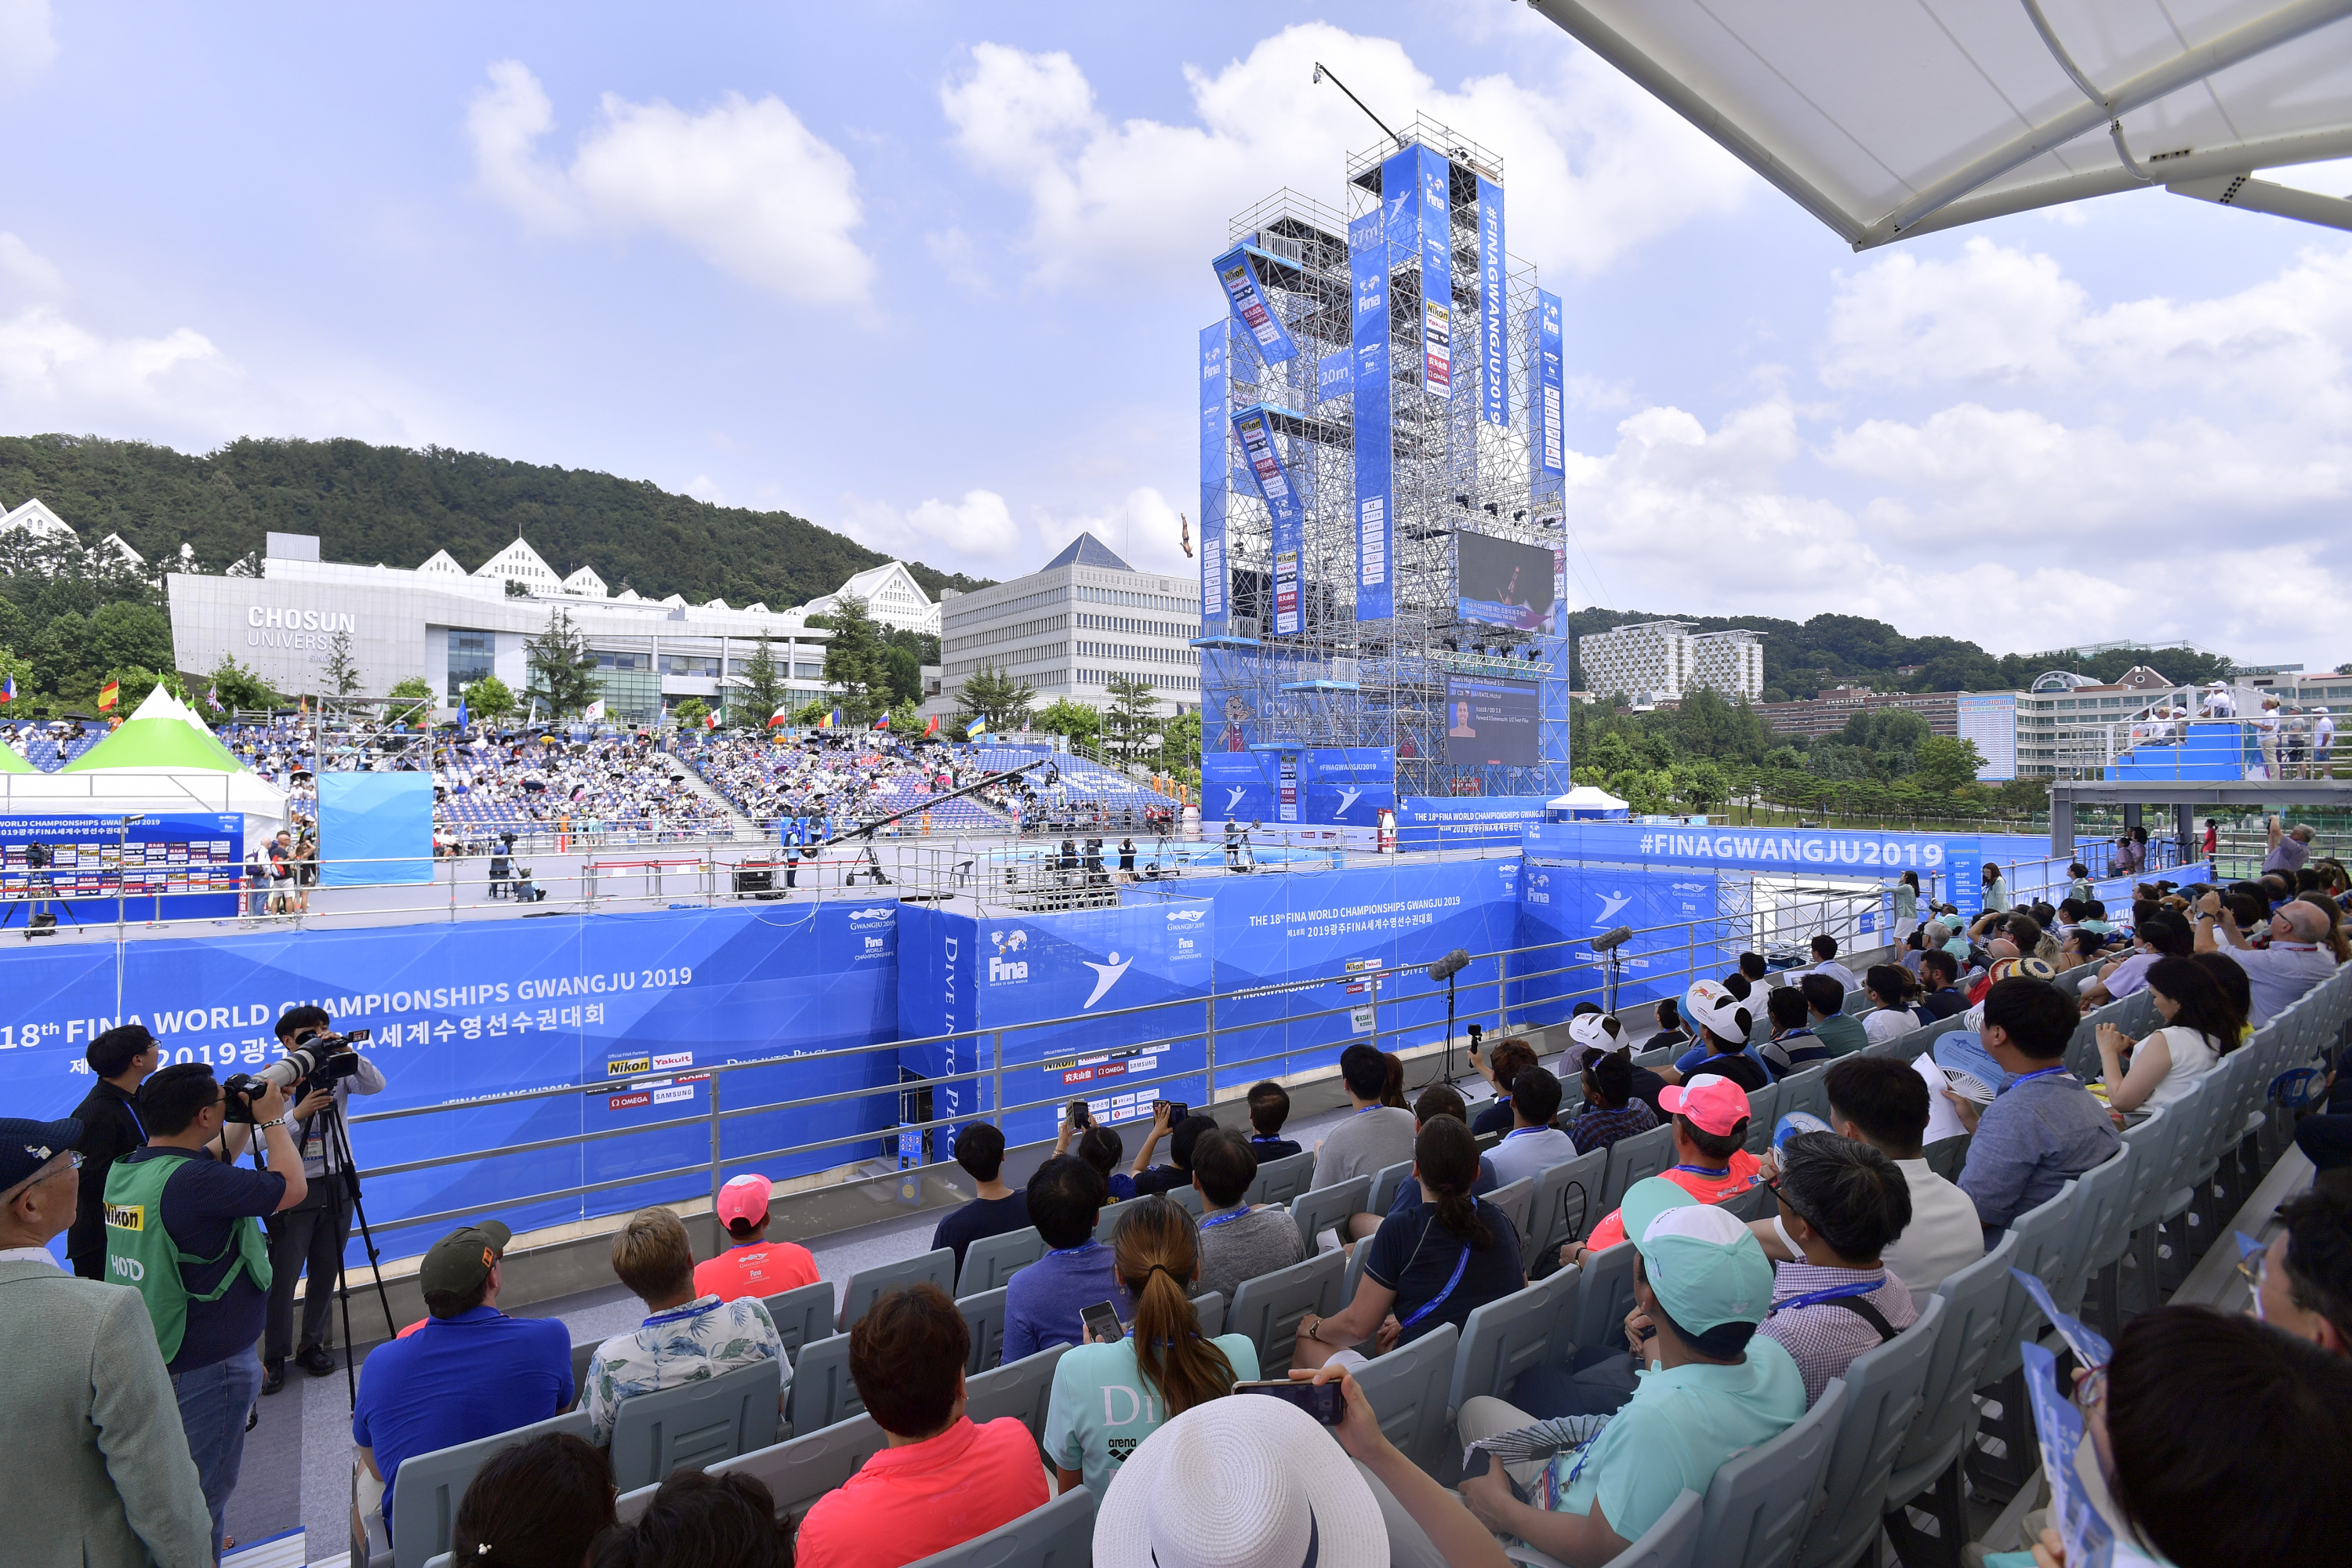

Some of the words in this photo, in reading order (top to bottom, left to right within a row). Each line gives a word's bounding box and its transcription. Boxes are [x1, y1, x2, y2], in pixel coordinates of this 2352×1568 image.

[1426, 187, 1445, 211] Fina
[1351, 226, 1377, 248] 27m
[1225, 268, 1244, 283] Nikon
[1229, 278, 1248, 289] Yakult
[1358, 294, 1381, 314] Fina
[1427, 303, 1449, 321] Nikon
[1486, 205, 1501, 426] #FINAGWANGJU2019
[1428, 318, 1448, 332] Yakult
[1203, 364, 1221, 380] Fina
[1321, 367, 1348, 387] 20m
[1432, 372, 1449, 383] OMEGA
[1241, 420, 1261, 432] Nikon
[1245, 431, 1263, 441] Yakult
[1277, 554, 1296, 563] Nikon
[248, 606, 355, 633] CHOSUN
[1439, 812, 1453, 821] FINA
[1453, 812, 1474, 821] WORLD
[1475, 811, 1519, 820] CHAMPIONSHIPS
[1520, 810, 1545, 818] GWANGJU
[1639, 833, 1943, 868] #FINAGWANGJU2019
[1527, 887, 1550, 904] Fina
[1249, 914, 1268, 927] THE
[1270, 913, 1286, 925] 18th
[1286, 911, 1307, 923] FINA
[1308, 908, 1338, 920] WORLD
[1340, 901, 1405, 918] CHAMPIONSHIPS
[1406, 897, 1443, 911] GWANGJU
[1443, 895, 1461, 907] 2019
[1682, 902, 1696, 911] Fina
[850, 922, 882, 931] GWANGJU
[1287, 928, 1305, 938] 제18회
[1307, 912, 1433, 938] 2019광주FINA세계수영선수권대회
[865, 936, 884, 948] Fina
[1179, 938, 1193, 949] Fina
[854, 950, 895, 960] CHAMPIONSHIPS
[1169, 953, 1202, 961] CHAMPIONSHIPS
[945, 935, 959, 1004] DIVE
[989, 956, 1029, 982] Fina
[1345, 962, 1363, 971] Nikon
[1, 1022, 60, 1050] 18th
[154, 1004, 270, 1035] WORLD
[278, 982, 510, 1019] CAMPIONSHIPS
[517, 971, 636, 1000] GWANGJU
[641, 966, 693, 989] 2019
[655, 1055, 691, 1065] Yakult
[1130, 1059, 1156, 1069] SAMSUNG
[609, 1061, 648, 1074] Nikon
[1105, 1065, 1125, 1074] OMEGA
[1065, 1069, 1092, 1082] 农夫山泉
[621, 1095, 648, 1105] OMEGA
[655, 1089, 692, 1100] SAMSUNG
[103, 1202, 139, 1229] Nikon
[1108, 1438, 1137, 1448] arena
